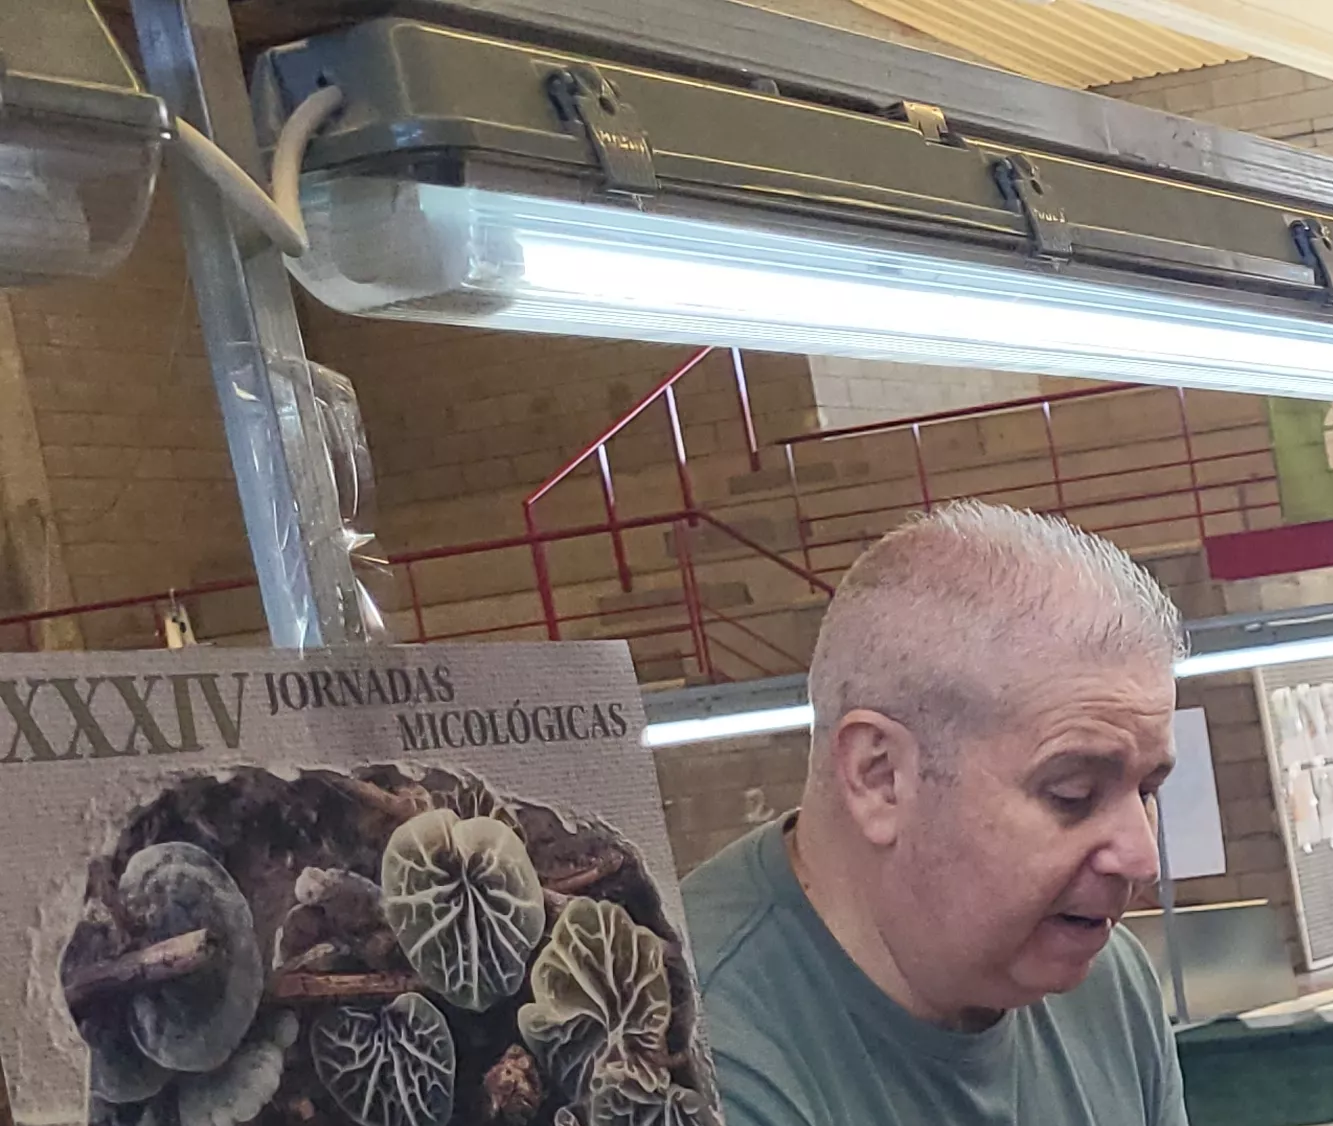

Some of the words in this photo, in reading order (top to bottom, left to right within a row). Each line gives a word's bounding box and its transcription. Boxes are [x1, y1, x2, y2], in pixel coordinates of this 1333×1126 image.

[0, 673, 249, 763] XXXIV
[265, 663, 455, 716] JORNADAS
[396, 698, 629, 752] MICOLÓGICAS
